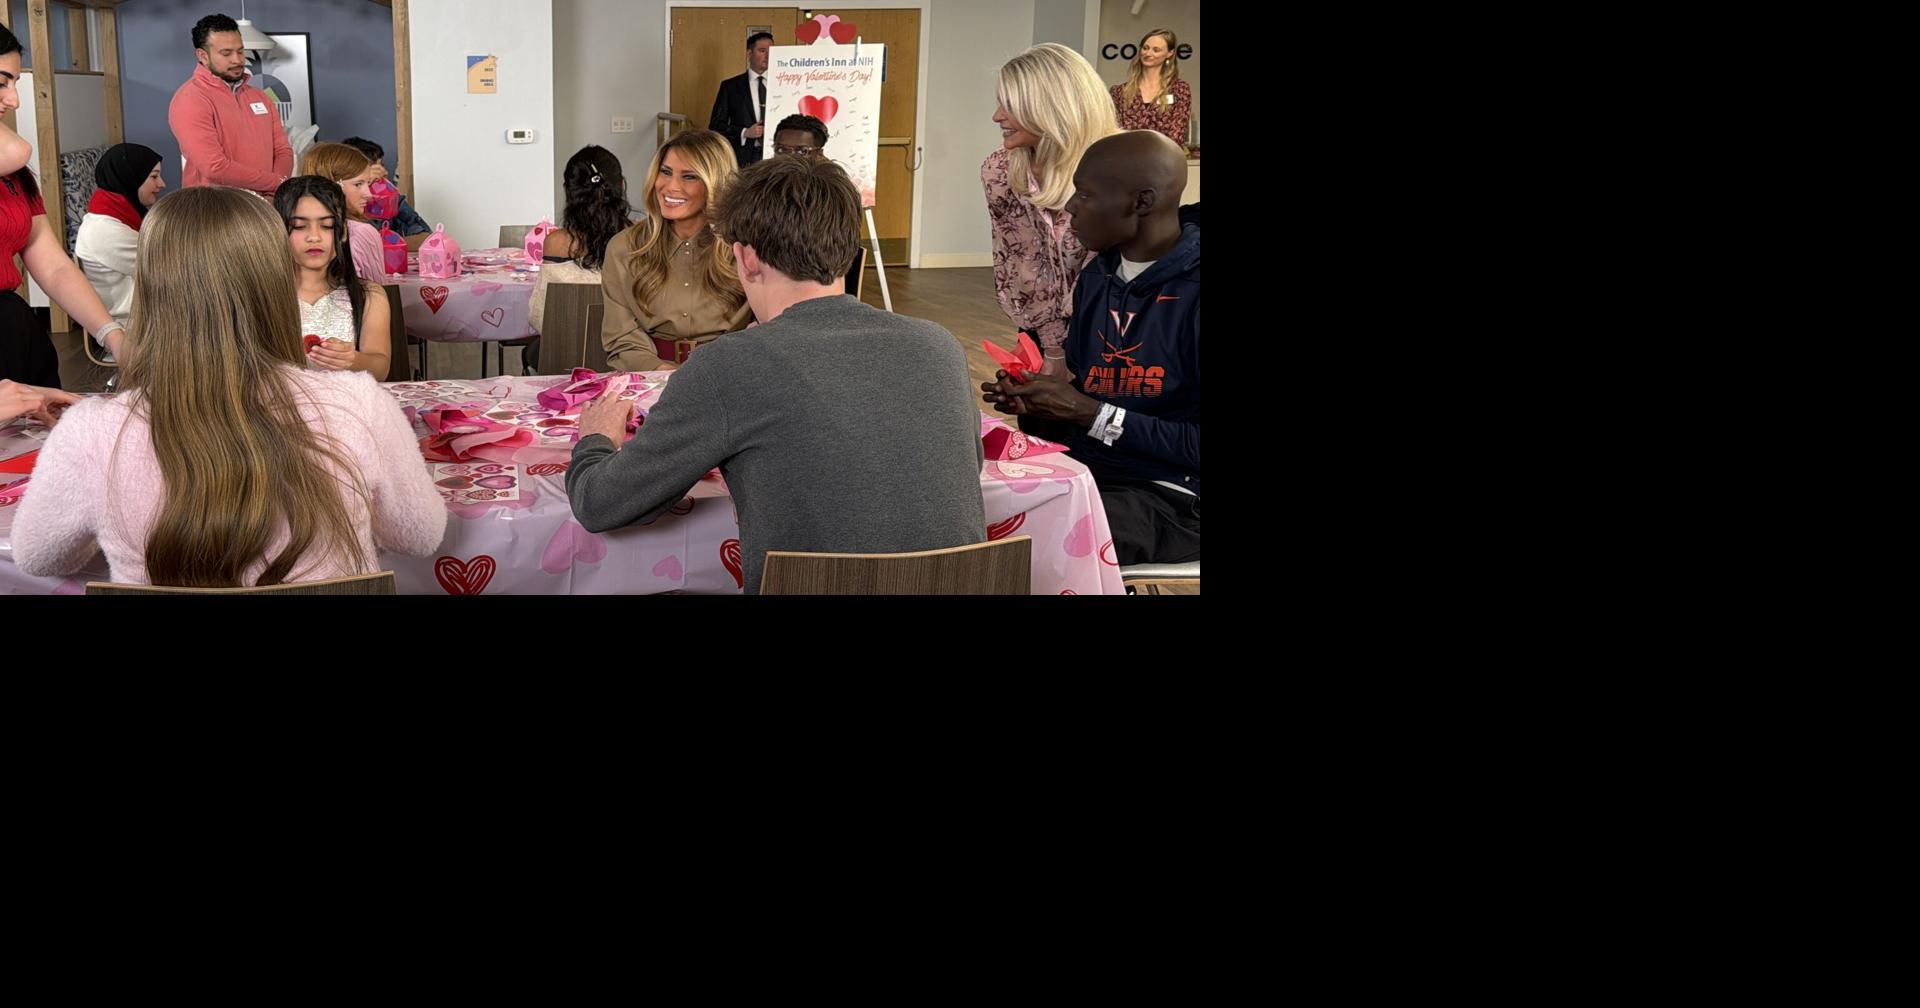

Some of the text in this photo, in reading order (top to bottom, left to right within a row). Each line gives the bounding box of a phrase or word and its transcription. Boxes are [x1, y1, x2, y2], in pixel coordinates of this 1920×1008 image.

[1102, 43, 1192, 60] coe
[789, 57, 830, 68] Children's
[831, 57, 847, 67] Inn
[858, 57, 873, 66] NIH
[776, 68, 873, 87] Happy Valentine's Day!
[1109, 309, 1137, 338] V
